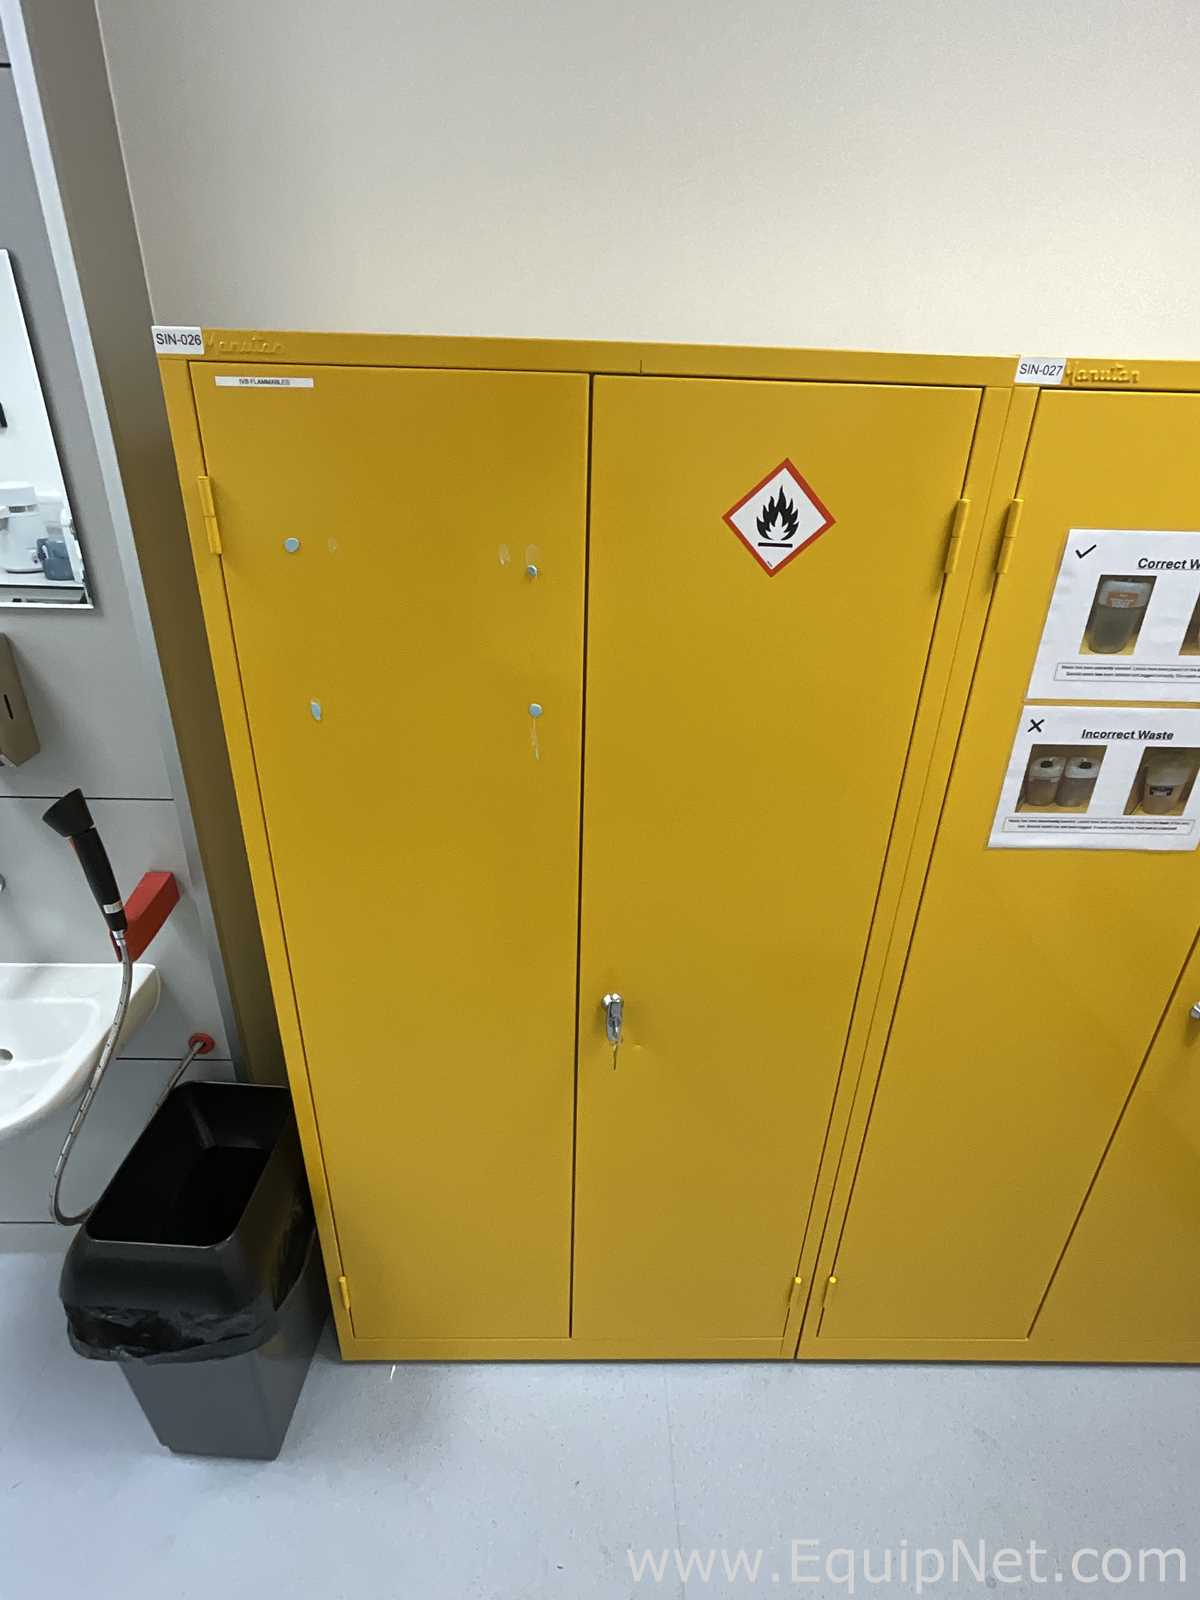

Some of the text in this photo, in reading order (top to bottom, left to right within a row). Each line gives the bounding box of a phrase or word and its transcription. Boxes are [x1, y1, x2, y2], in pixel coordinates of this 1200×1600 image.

[156, 333, 201, 346] SIN-026
[1019, 363, 1063, 377] SIN-027
[1137, 557, 1187, 570] Correct
[1081, 728, 1174, 741] Incorrect Waste
